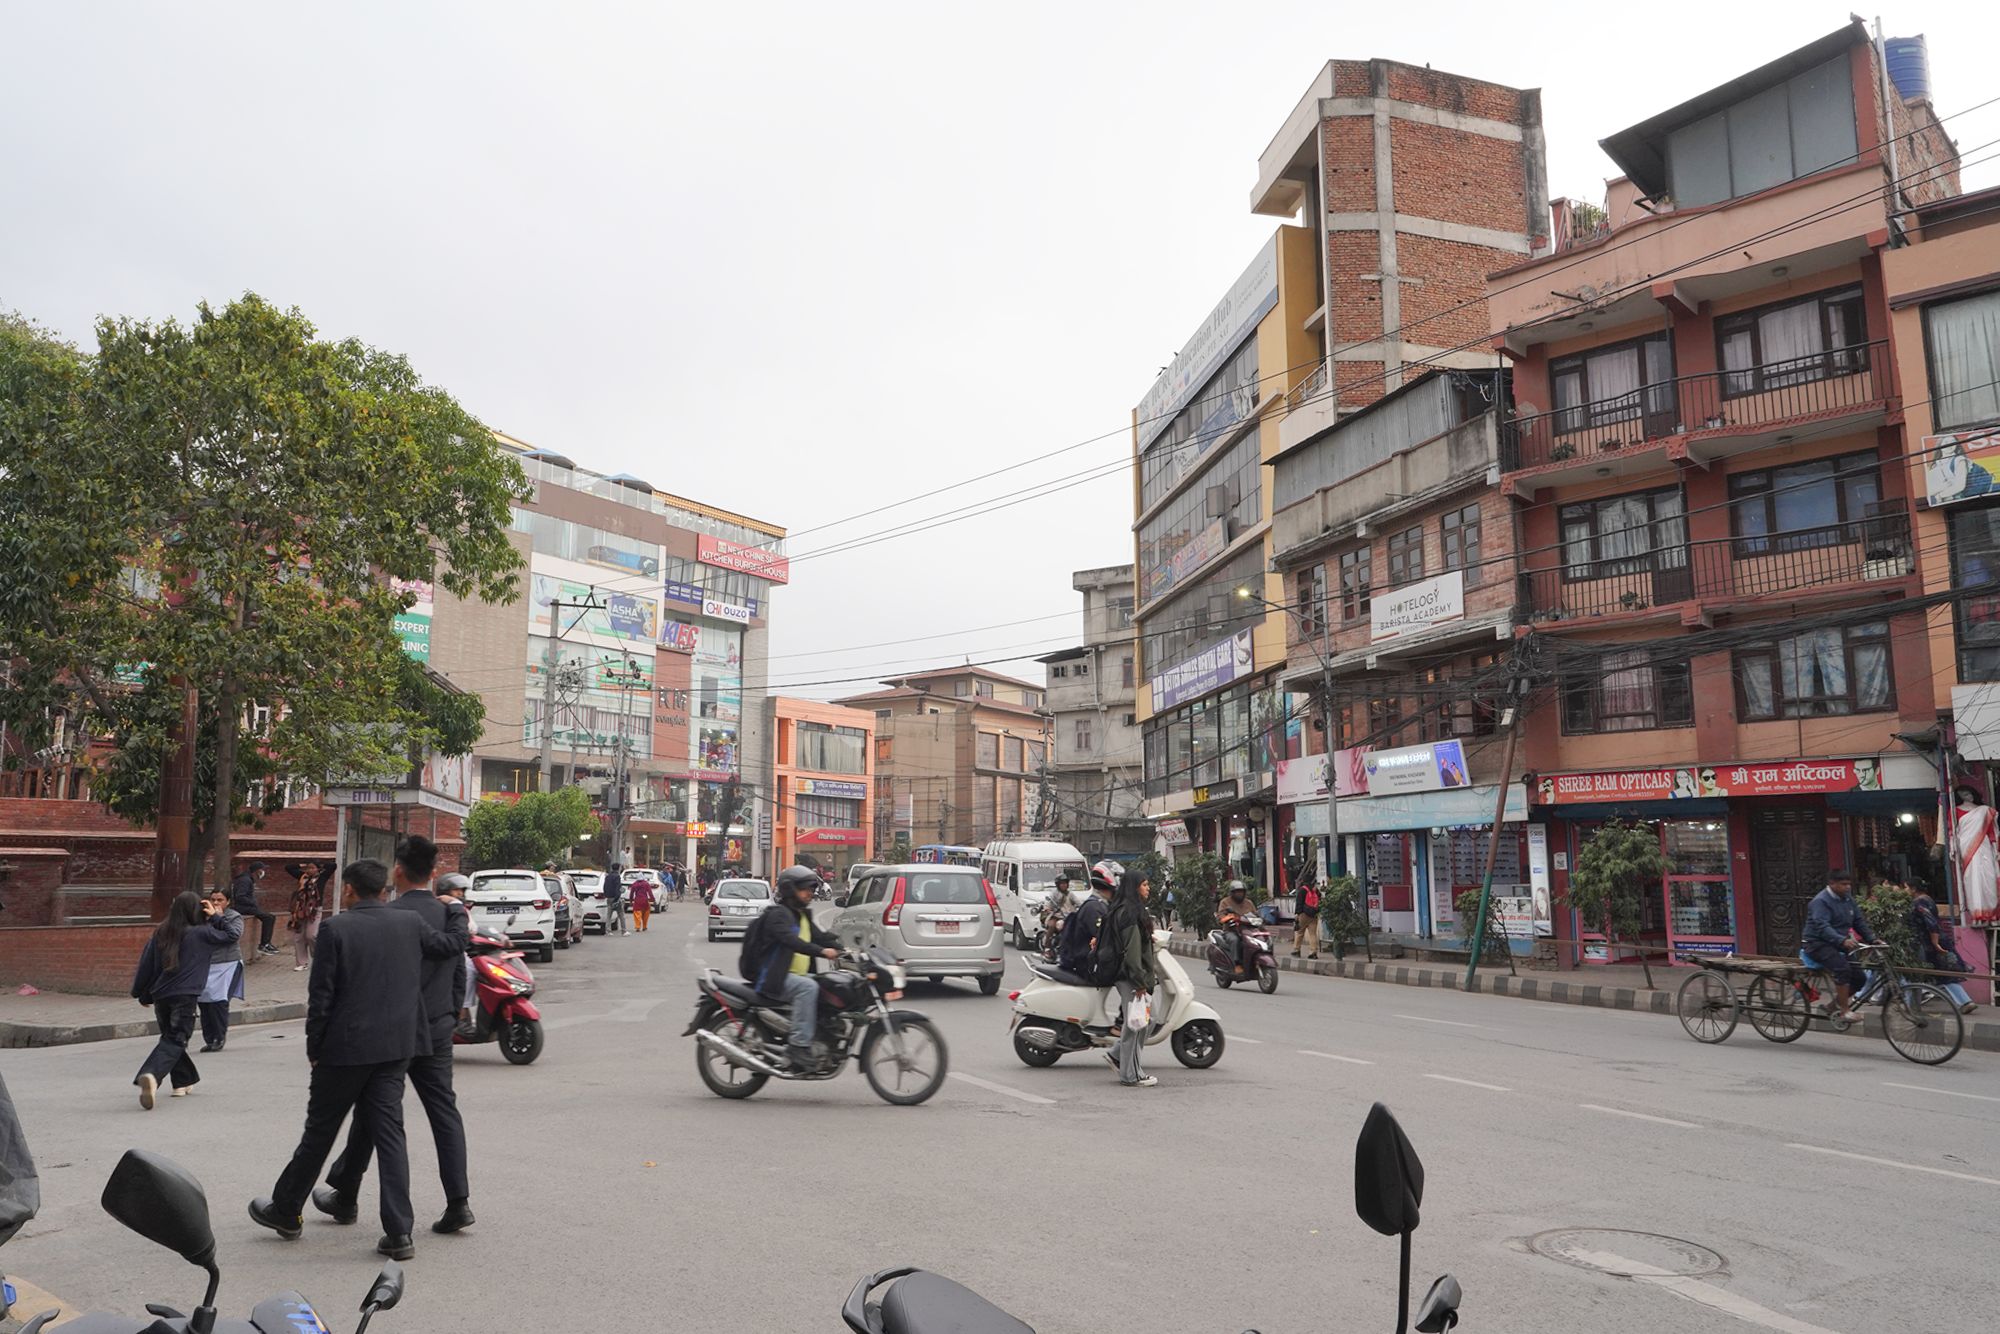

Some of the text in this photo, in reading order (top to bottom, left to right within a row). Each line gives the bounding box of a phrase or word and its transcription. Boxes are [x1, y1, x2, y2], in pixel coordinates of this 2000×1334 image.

[1213, 298, 1232, 331] Hub
[701, 550, 733, 566] KITCHEN
[764, 565, 787, 578] HOUSE
[727, 545, 773, 563] NEW CHINESE
[612, 604, 638, 617] ASHA
[723, 606, 747, 618] OUZO
[1390, 589, 1440, 616] HOTELOGY
[394, 621, 430, 634] EXPERT
[1380, 615, 1412, 631] BARISTA
[1413, 602, 1452, 621] ACADEMY
[401, 641, 429, 653] LINIC
[1558, 771, 1672, 793] SHREE RAM OPTICALS
[1731, 763, 1846, 785] श्री राम अप्टिकल
